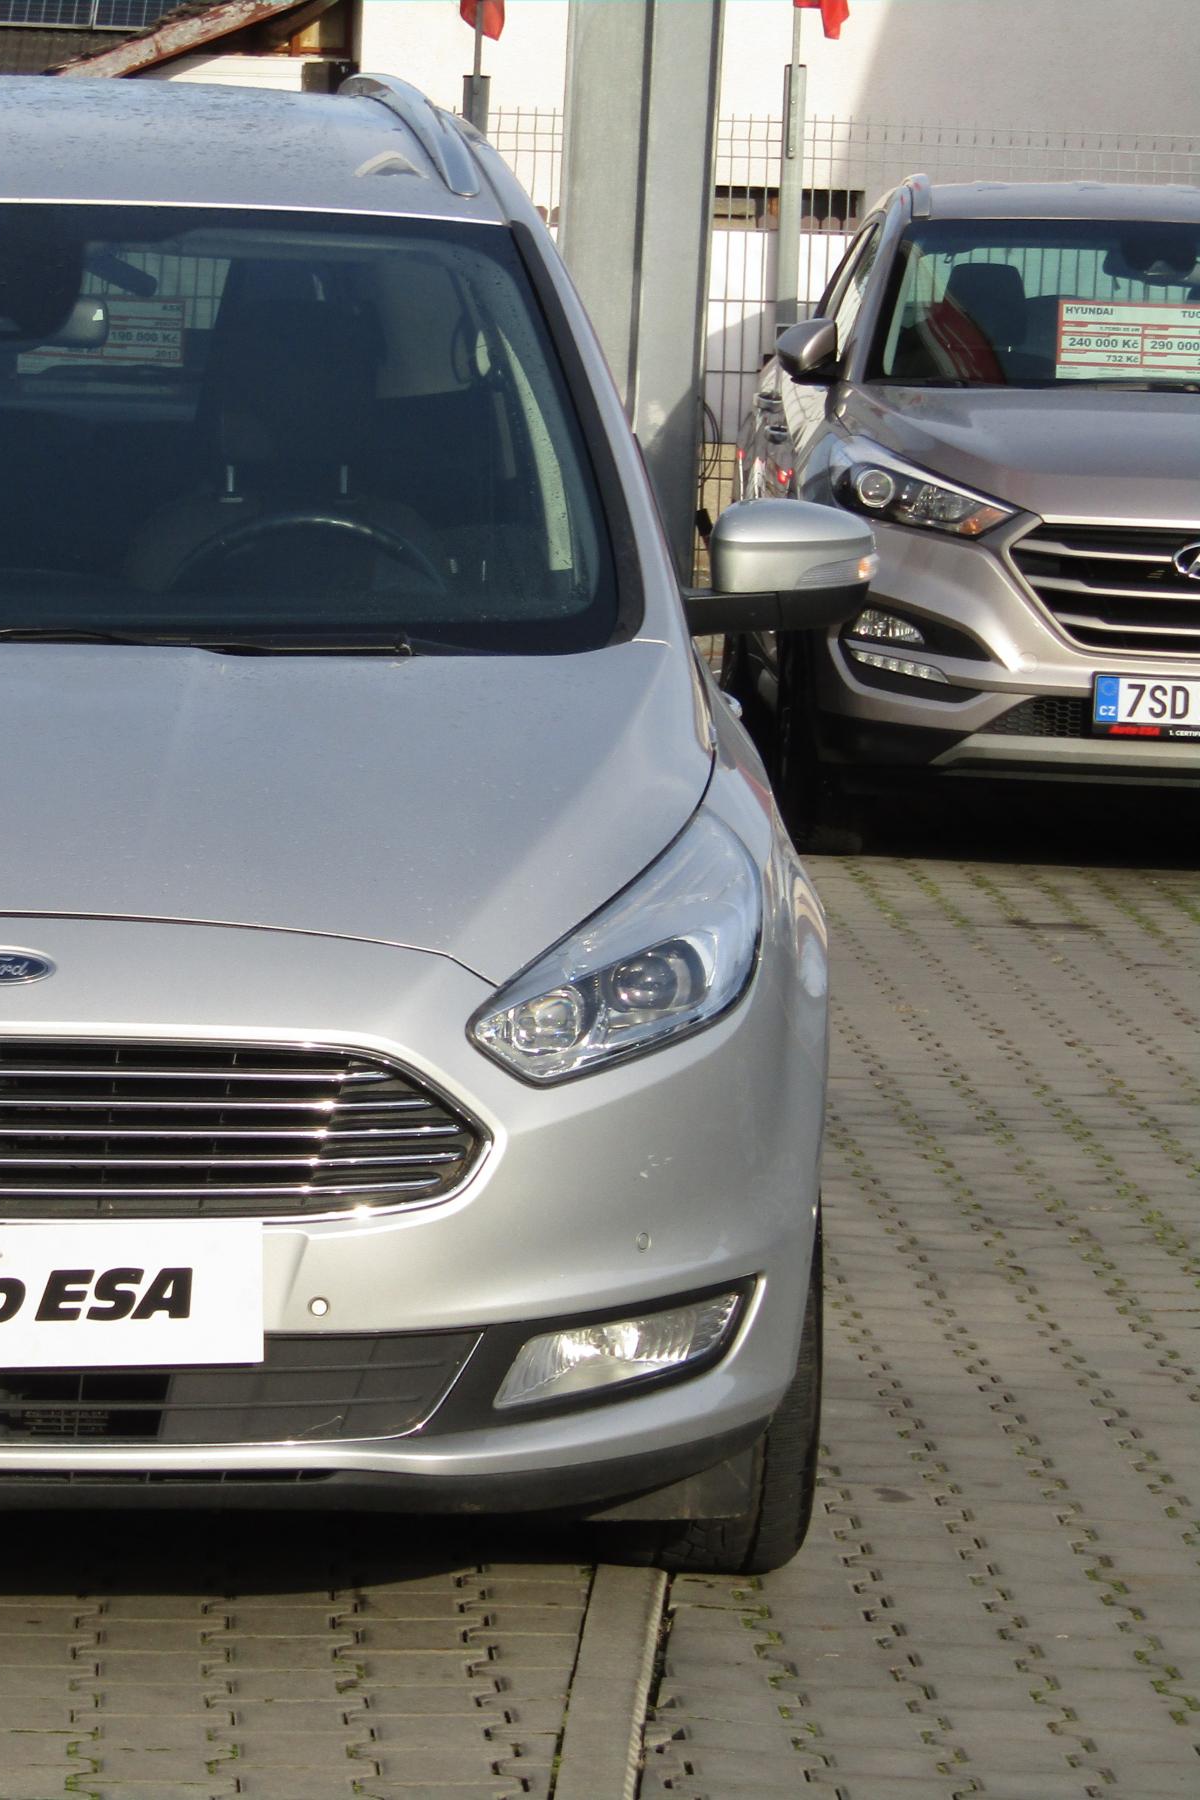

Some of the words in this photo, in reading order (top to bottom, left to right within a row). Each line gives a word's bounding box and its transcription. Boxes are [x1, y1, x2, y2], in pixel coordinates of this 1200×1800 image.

[1065, 306, 1114, 316] HYUNDAI
[1068, 337, 1092, 347] 240
[1095, 338, 1118, 348] 000
[1122, 338, 1139, 349] Kč
[1150, 341, 1173, 350] 290
[1177, 341, 1200, 351] 000
[1105, 355, 1123, 363] 732
[1126, 355, 1139, 364] Kč
[1126, 683, 1190, 720] 7SD
[1099, 705, 1116, 716] CZ
[34, 1266, 193, 1321] ESA
